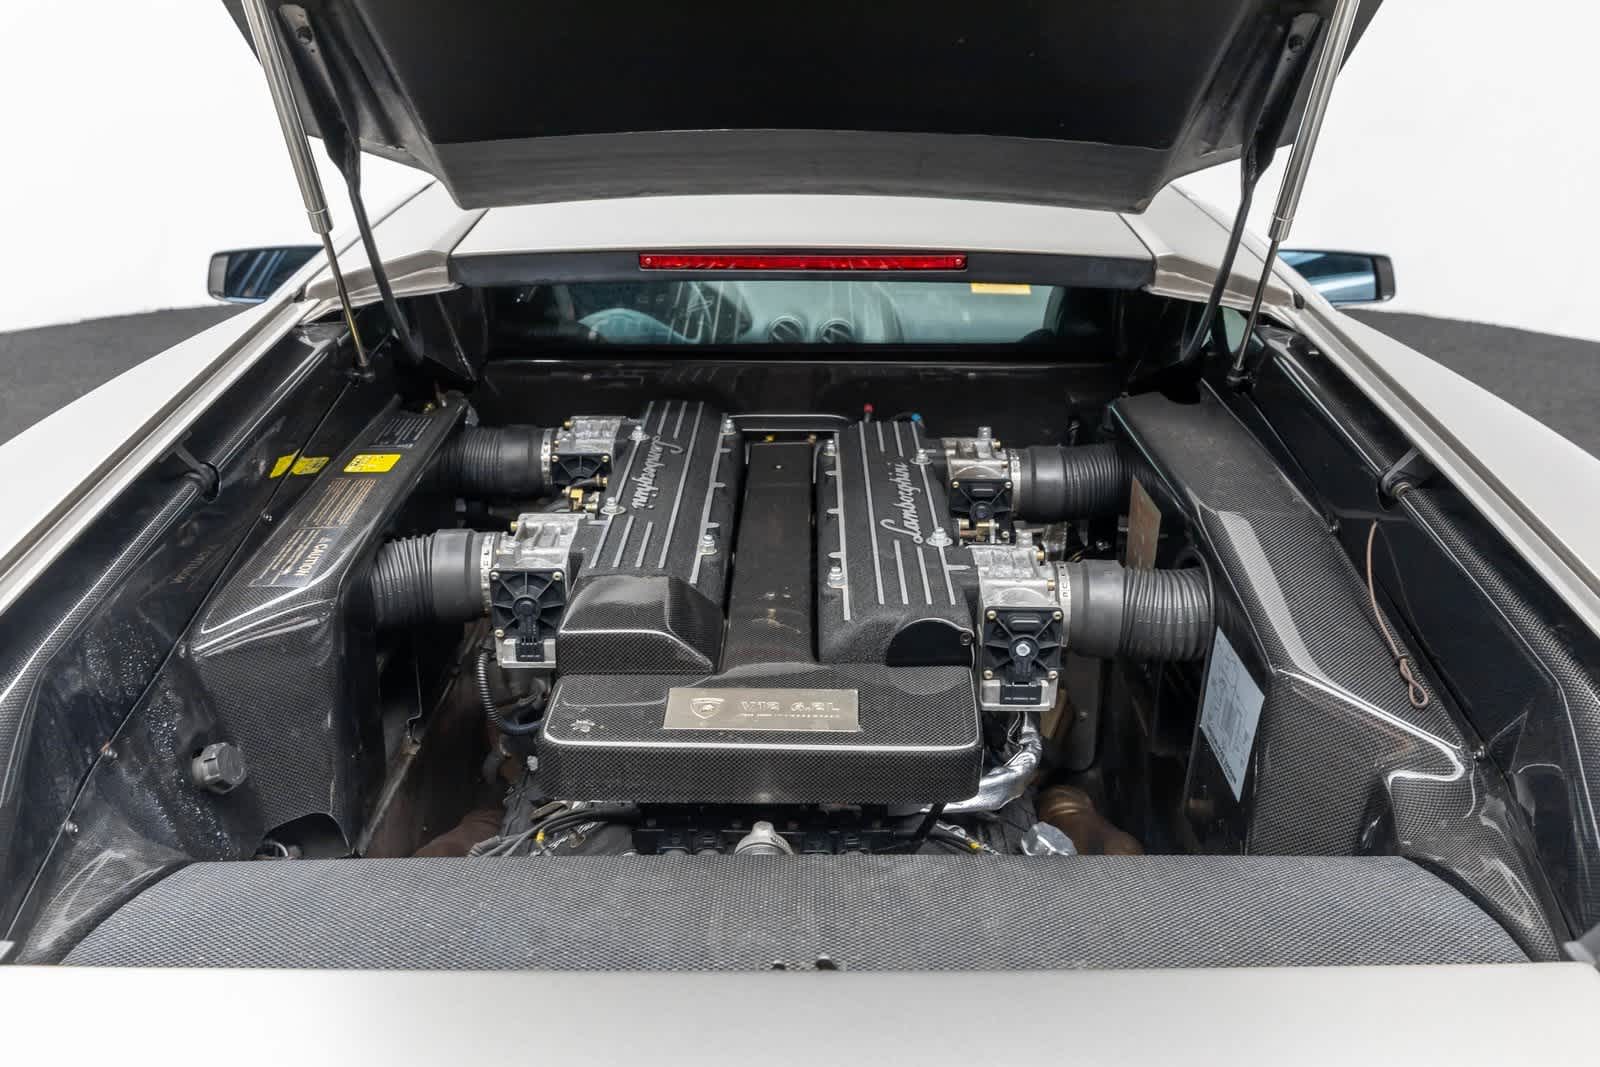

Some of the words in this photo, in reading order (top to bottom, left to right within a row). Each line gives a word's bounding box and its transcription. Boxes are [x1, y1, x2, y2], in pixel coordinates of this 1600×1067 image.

[631, 436, 684, 509] Lamborghini
[880, 462, 924, 544] Lamborghini
[295, 544, 328, 576] CAUTION
